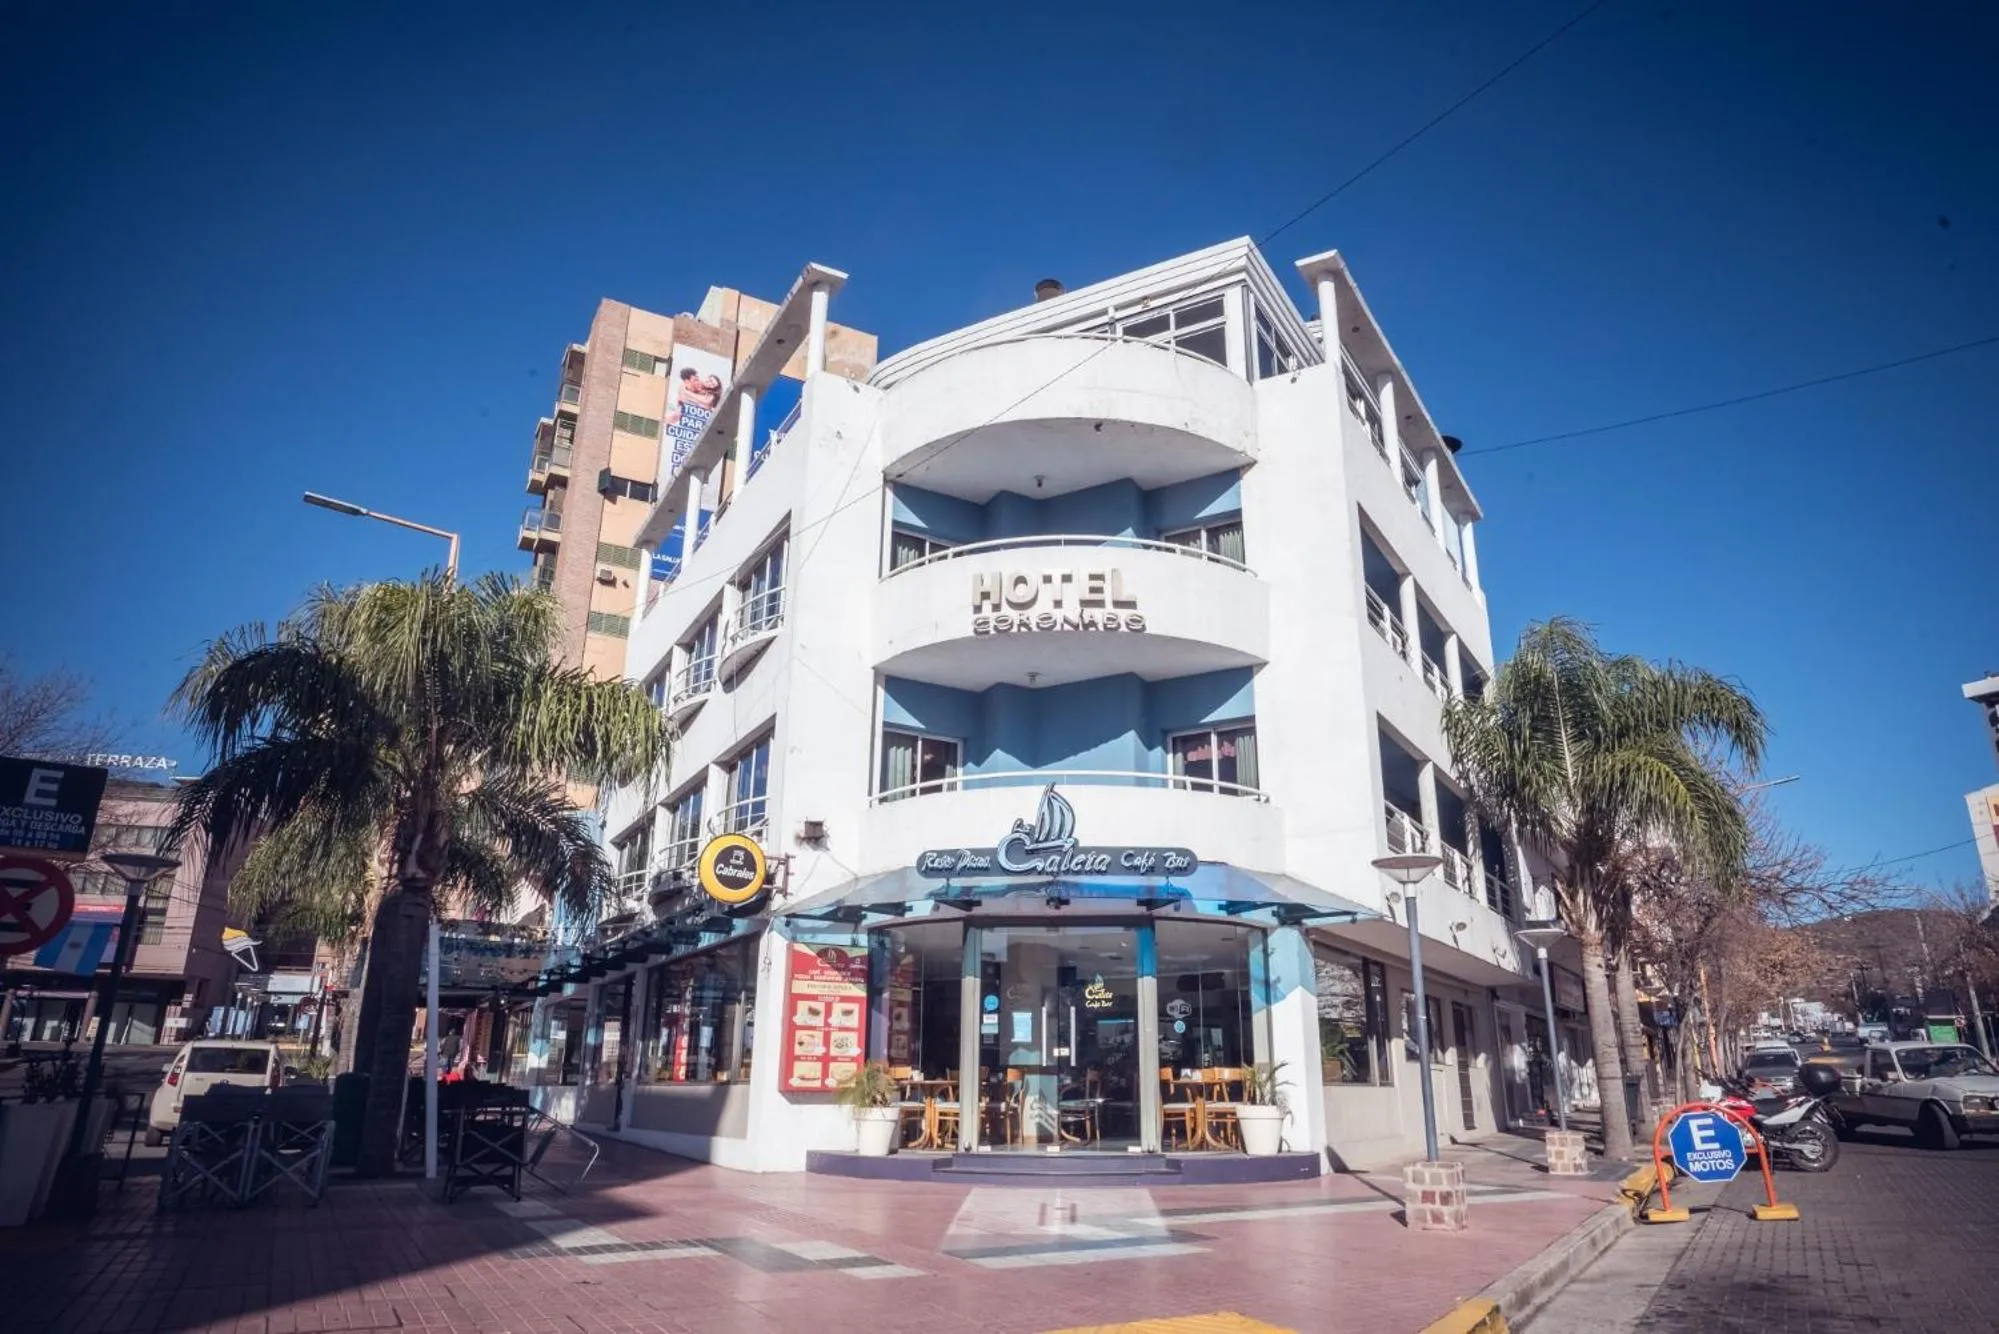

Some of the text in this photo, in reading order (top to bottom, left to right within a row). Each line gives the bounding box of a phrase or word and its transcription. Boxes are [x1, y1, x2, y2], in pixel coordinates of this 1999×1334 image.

[684, 404, 712, 419] TODO
[680, 417, 704, 430] PAR
[972, 567, 1138, 611] HOTEL
[973, 608, 1147, 635] CORONADO
[86, 753, 168, 770] TERRAZA
[24, 767, 65, 807] E
[0, 805, 83, 824] XCLUSIVO
[1120, 850, 1156, 873] Café
[715, 863, 755, 880] Cabrales
[1688, 1118, 1720, 1150] E
[1686, 1149, 1732, 1161] EXCLUSIVO
[1689, 1160, 1735, 1173] MOTOS
